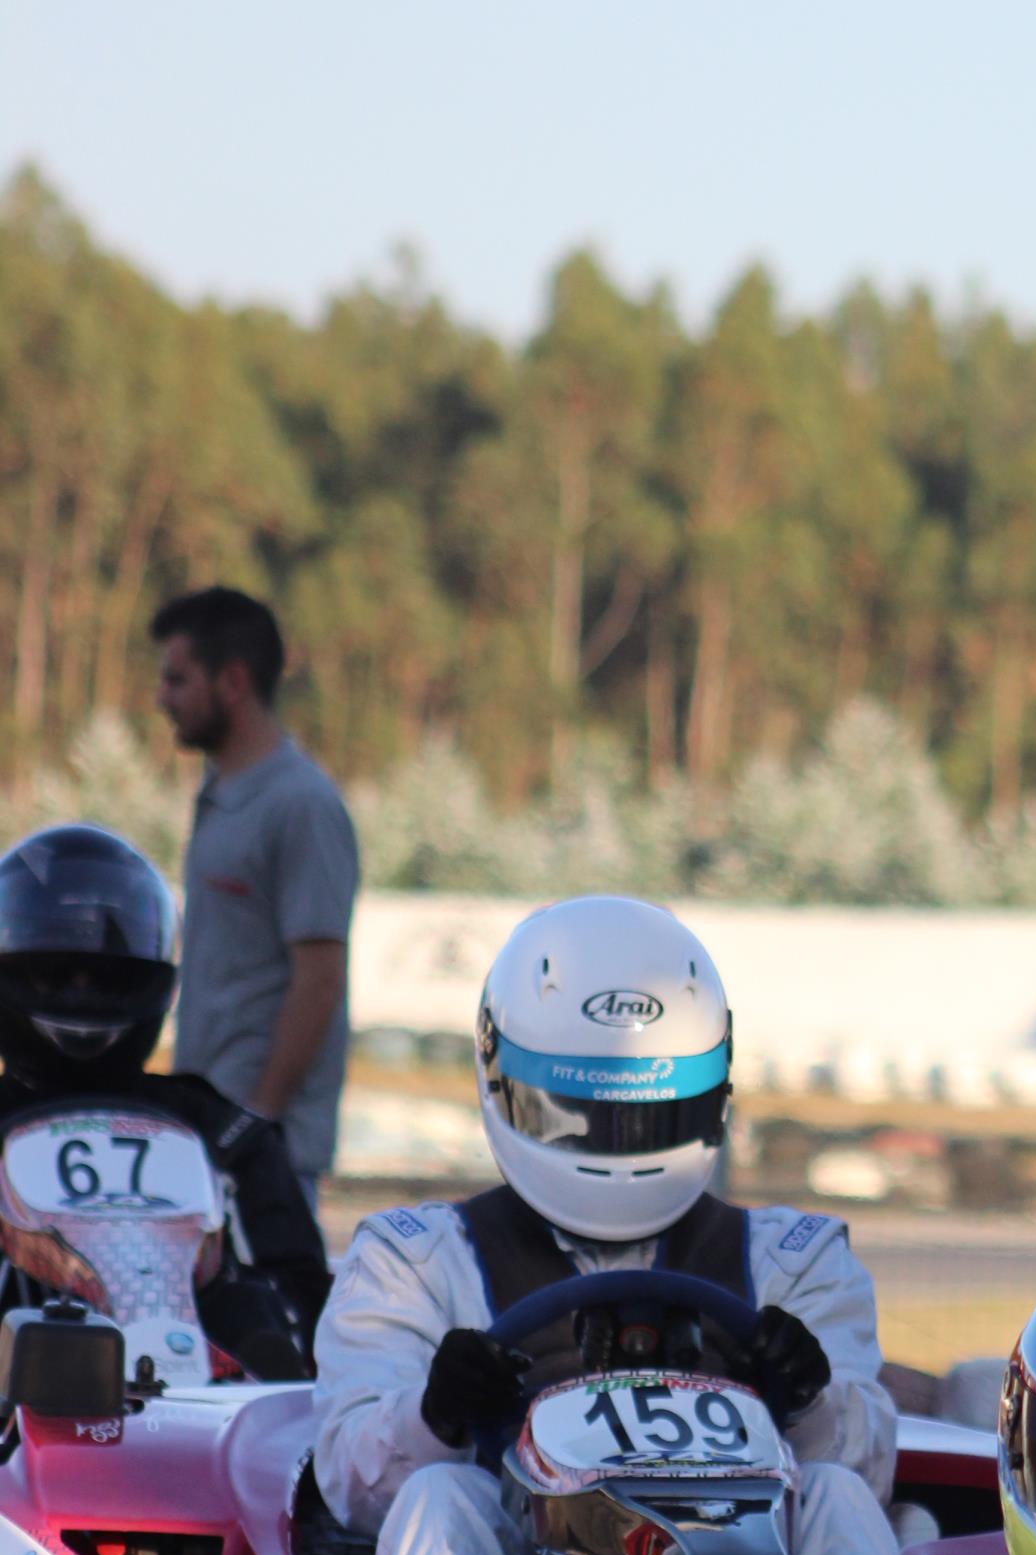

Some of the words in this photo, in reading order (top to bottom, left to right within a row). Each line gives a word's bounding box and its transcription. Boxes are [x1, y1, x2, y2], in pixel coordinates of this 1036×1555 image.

[588, 994, 654, 1017] Arai
[552, 1065, 575, 1080] FIT
[587, 1071, 657, 1085] COMPANY
[57, 1136, 150, 1199] 67
[584, 1384, 748, 1453] 159
